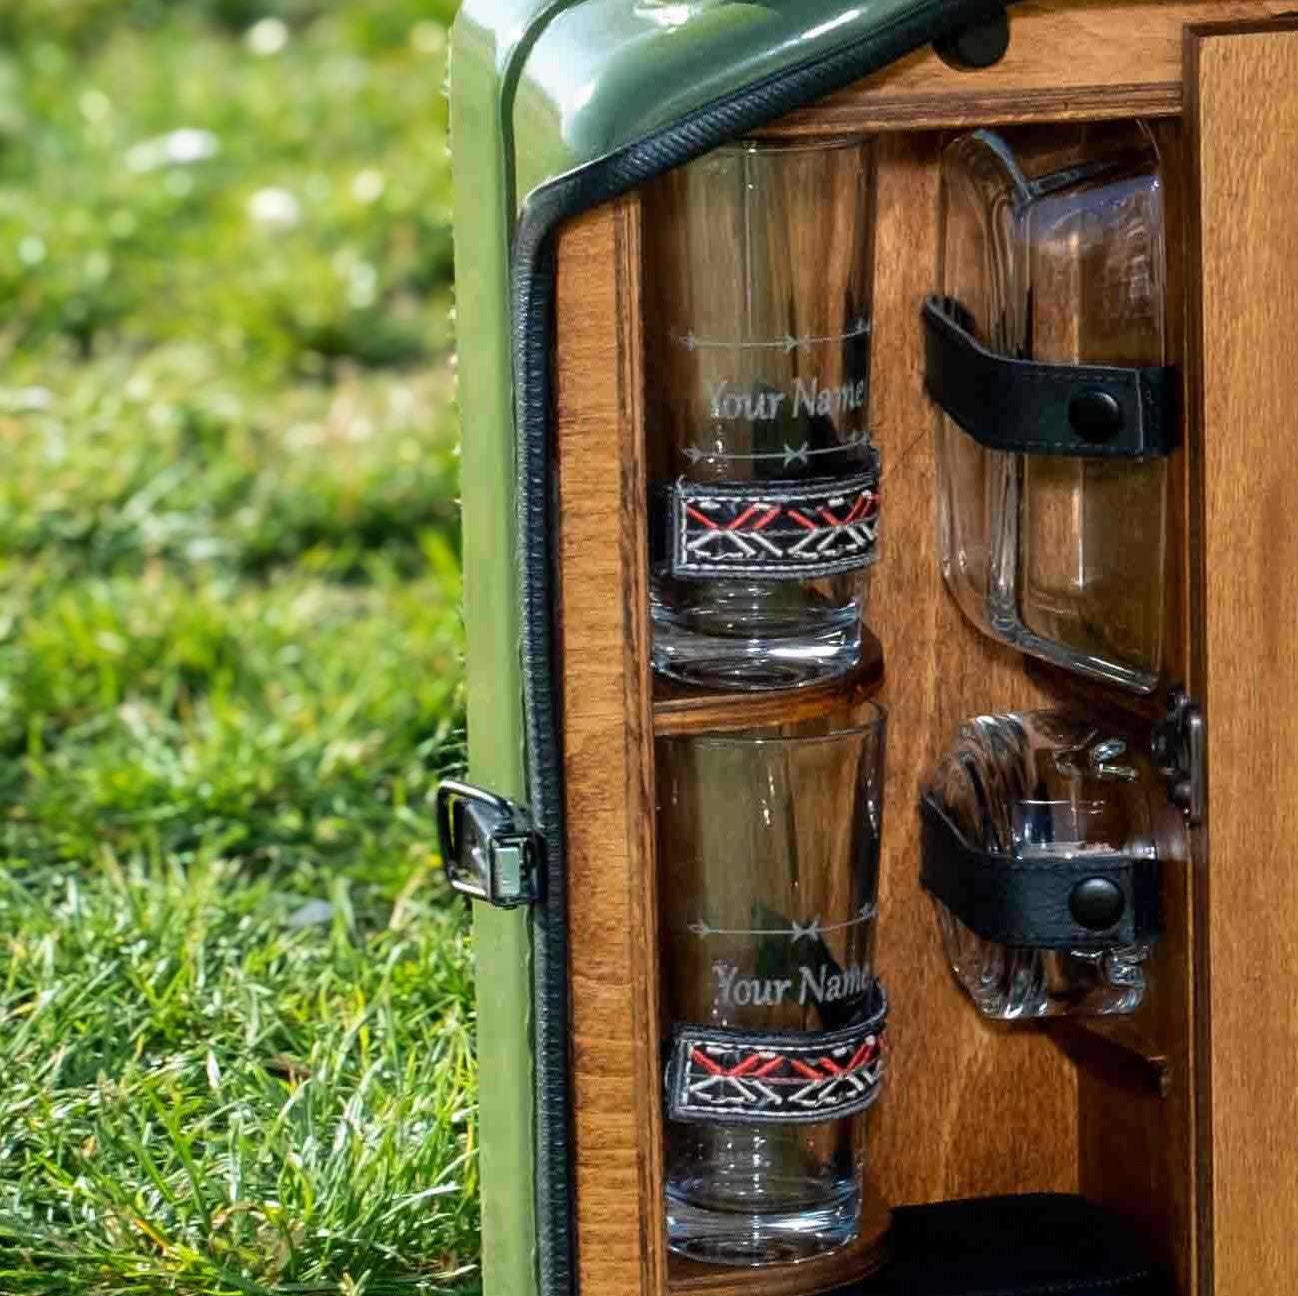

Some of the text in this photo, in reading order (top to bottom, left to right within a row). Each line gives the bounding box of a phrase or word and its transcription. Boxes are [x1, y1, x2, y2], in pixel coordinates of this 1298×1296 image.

[711, 376, 865, 422] Your Name
[712, 960, 792, 1007] Your
